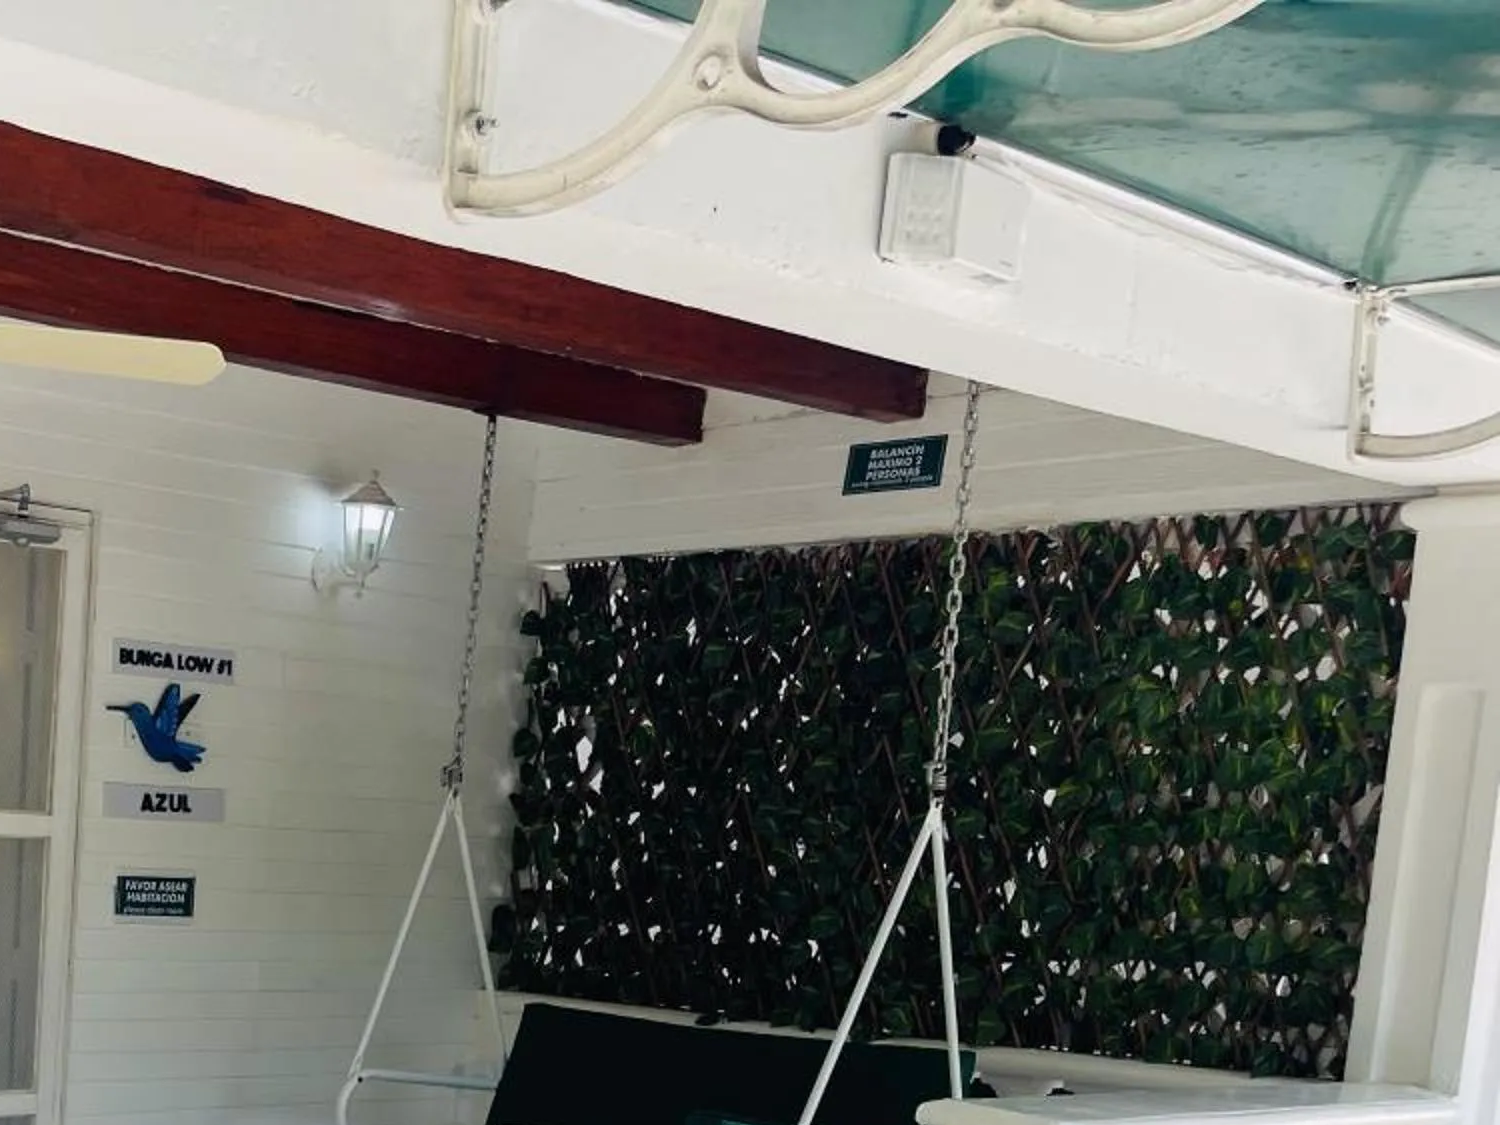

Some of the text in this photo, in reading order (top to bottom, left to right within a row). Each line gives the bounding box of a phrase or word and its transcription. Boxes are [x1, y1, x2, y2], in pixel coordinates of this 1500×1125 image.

[915, 455, 923, 465] 2
[865, 466, 921, 480] PERSONAS
[140, 793, 192, 813] AZUL
[125, 880, 188, 892] FAVOR ASEAR
